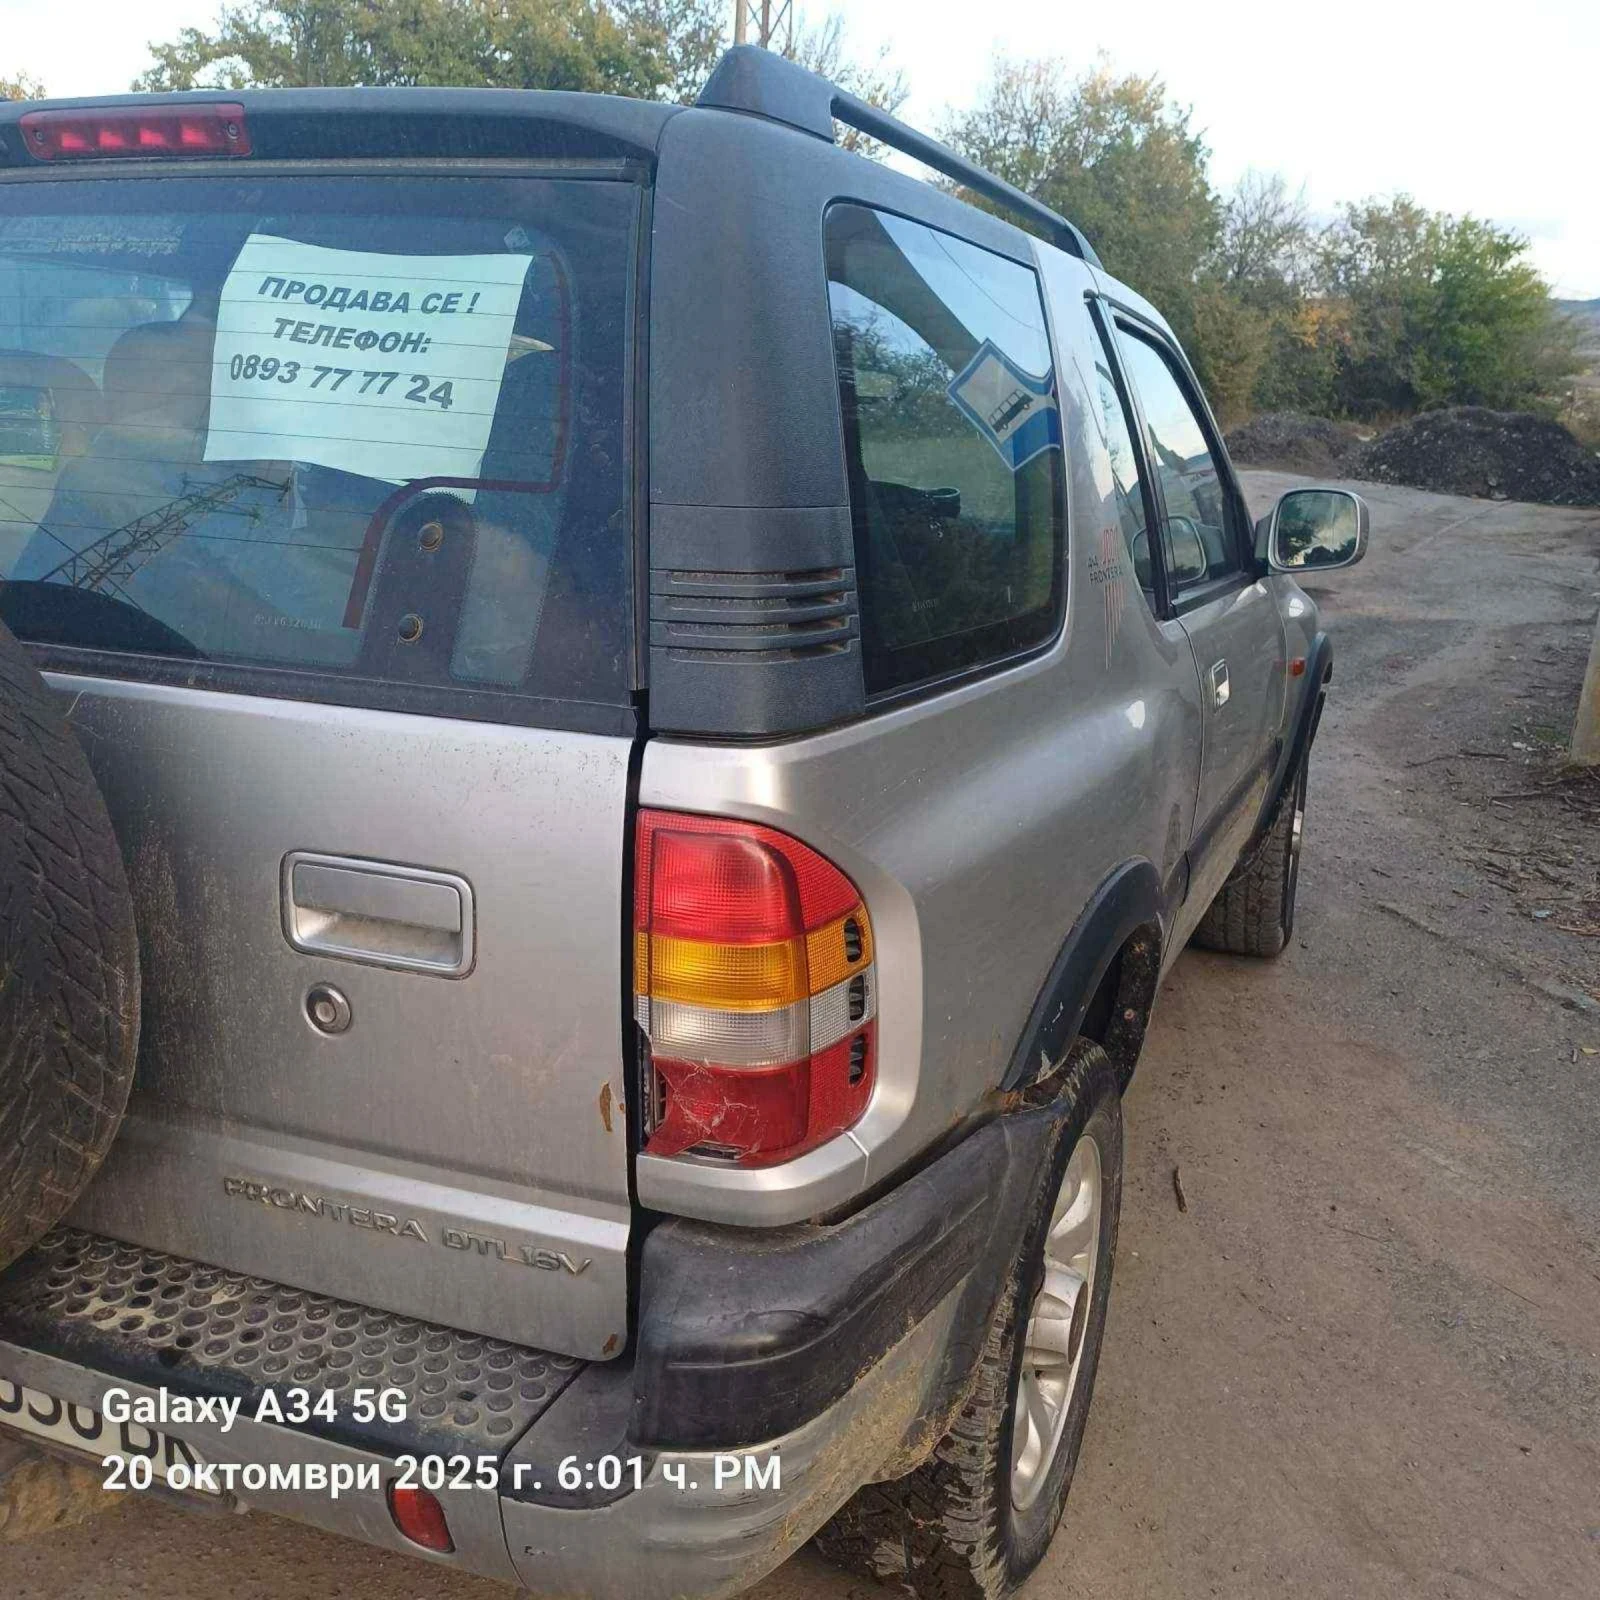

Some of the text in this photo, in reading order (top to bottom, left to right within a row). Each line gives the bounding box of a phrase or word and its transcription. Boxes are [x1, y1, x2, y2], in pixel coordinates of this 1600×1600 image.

[257, 275, 410, 314] ПРОДАВА
[273, 317, 432, 354] ТЕЛЕФОН:
[230, 353, 454, 410] 0893 77 77 24
[223, 1176, 430, 1244] FRONTERA
